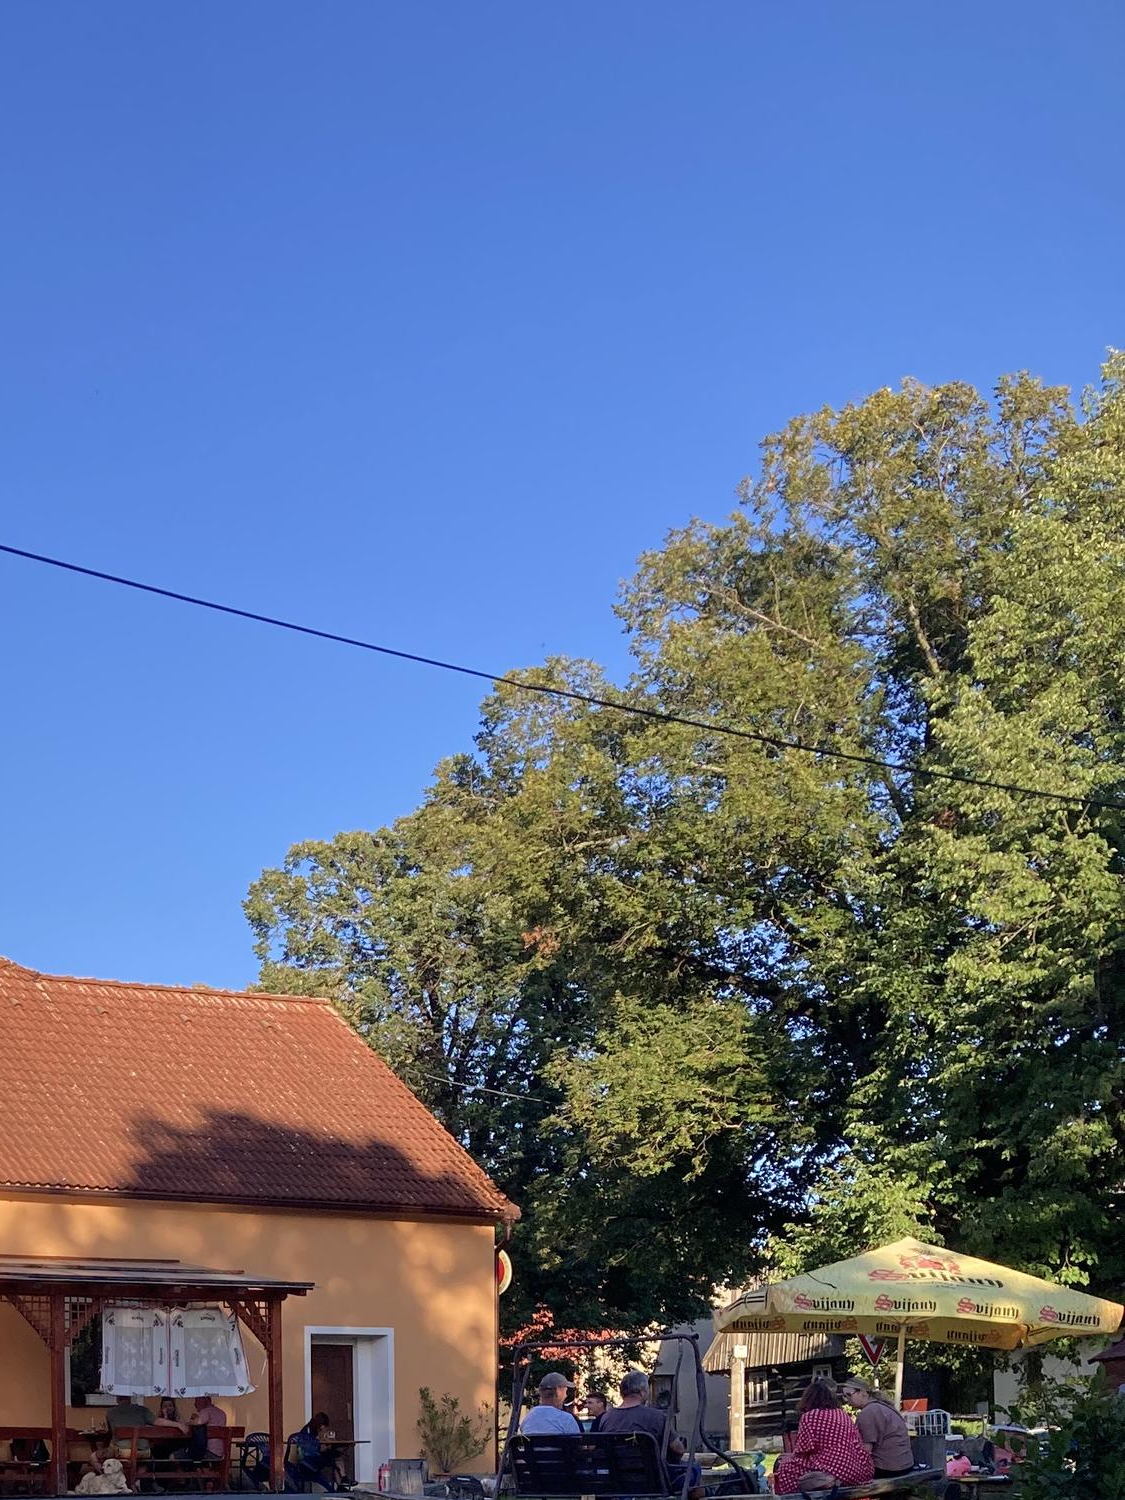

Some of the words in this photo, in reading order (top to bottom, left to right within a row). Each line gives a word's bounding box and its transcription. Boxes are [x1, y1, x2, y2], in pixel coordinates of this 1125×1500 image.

[794, 1293, 855, 1311] Svijany
[875, 1294, 937, 1312] Svijany
[957, 1297, 1019, 1319] Svijany
[1039, 1305, 1100, 1326] Svijany
